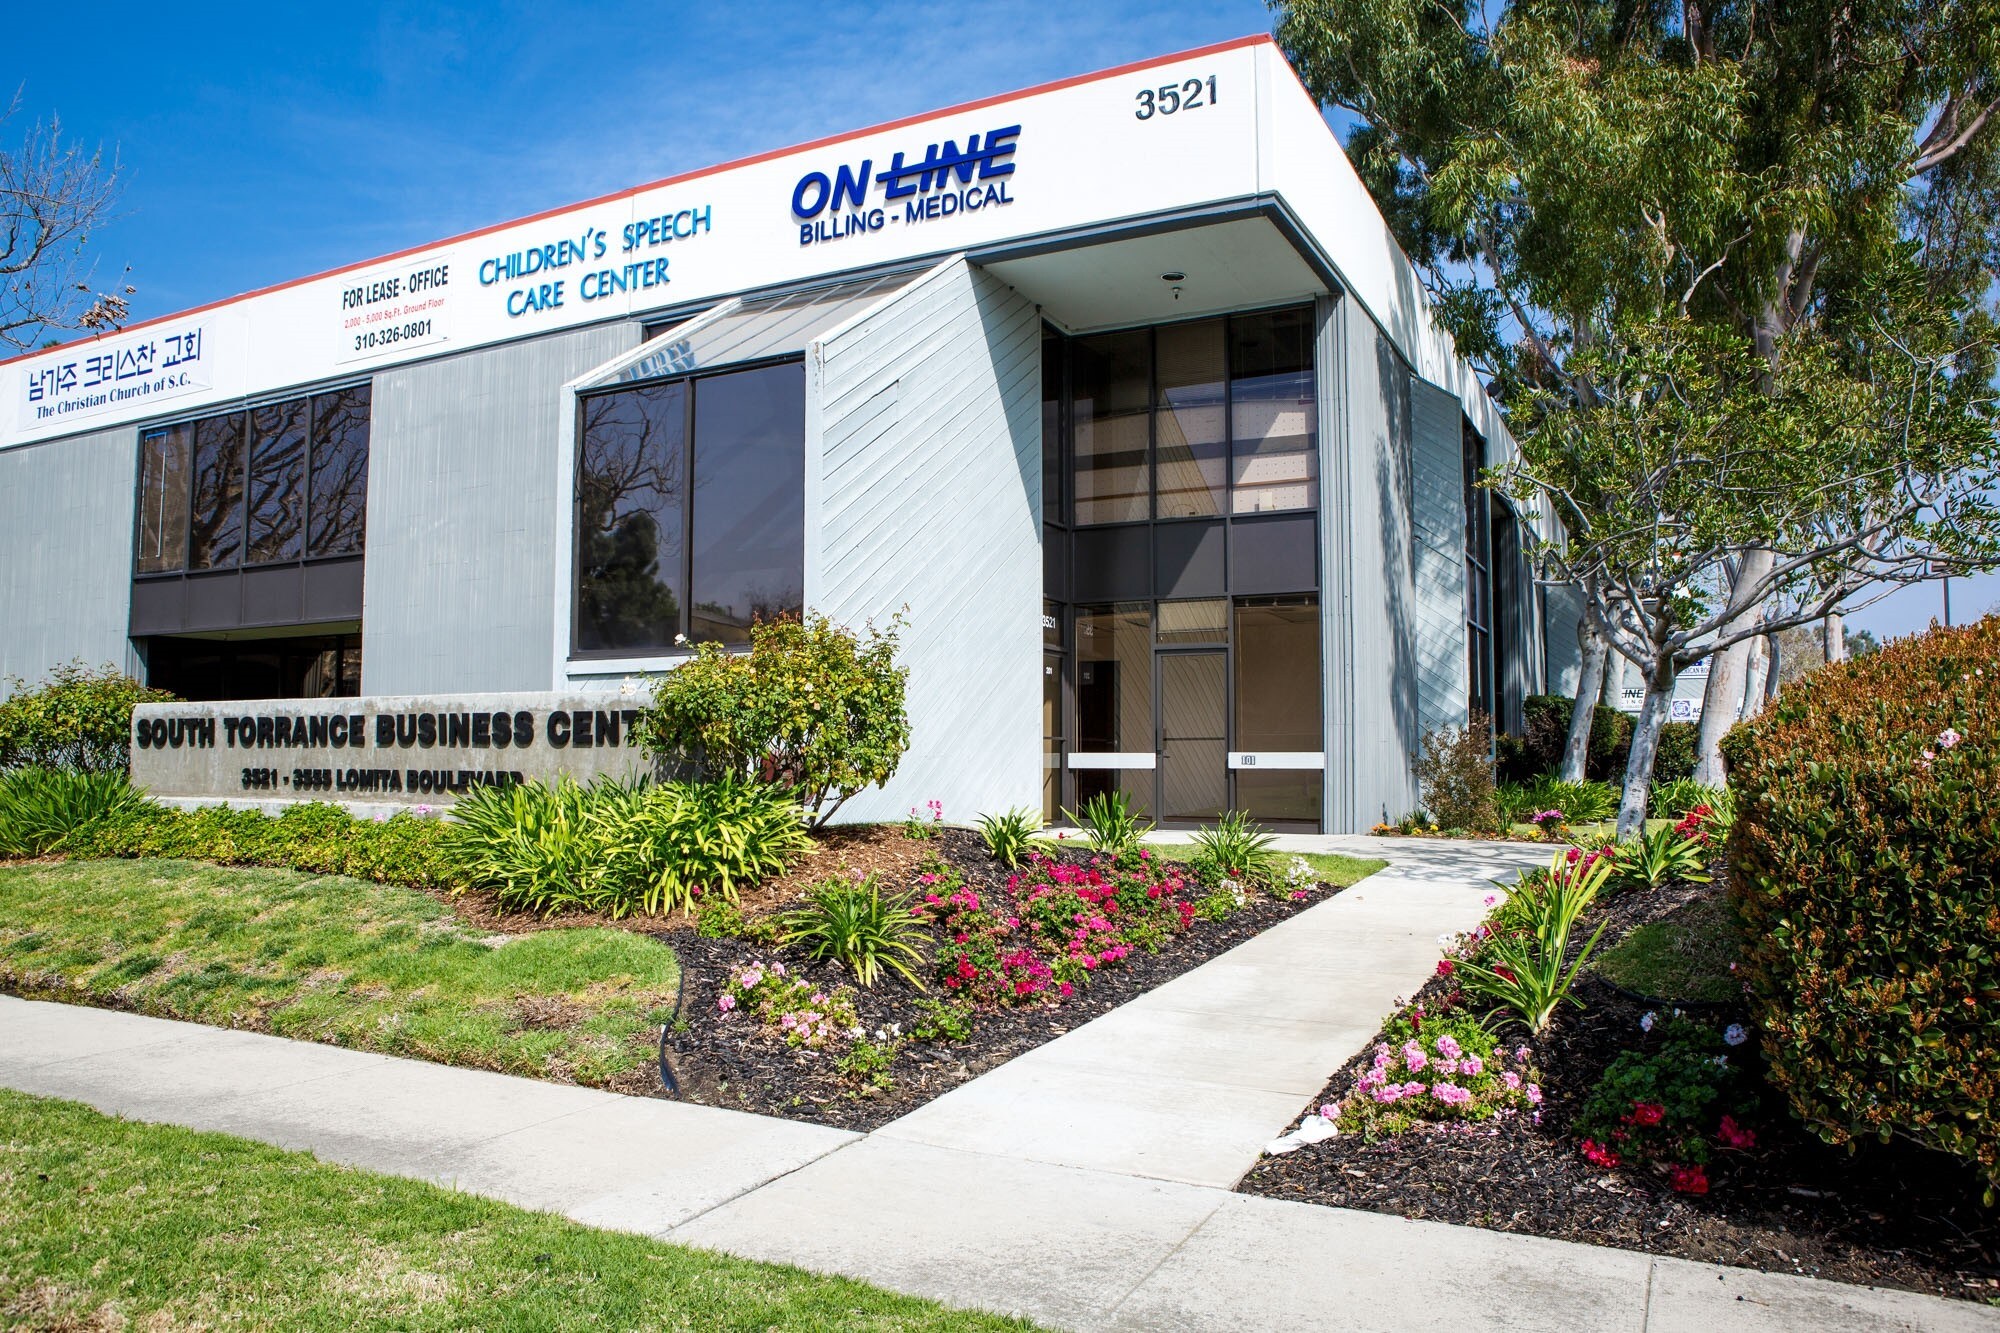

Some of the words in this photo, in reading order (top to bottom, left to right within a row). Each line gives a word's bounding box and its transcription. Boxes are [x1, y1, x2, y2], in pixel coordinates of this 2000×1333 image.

[1135, 74, 1217, 121] 3521
[799, 208, 885, 245] BILLING
[905, 181, 1014, 223] MEDICAL
[479, 226, 607, 285] CHILDREN'S
[622, 204, 711, 251] SPEECH
[342, 287, 363, 310] FOR
[366, 277, 400, 305] LEASE
[409, 265, 449, 293] OFFICE
[403, 301, 427, 314] Ground
[428, 298, 445, 308] Floor
[506, 280, 565, 316] CARE
[580, 257, 671, 301] CENTER
[355, 319, 431, 351] 310-326-0801
[29, 363, 77, 402] 남가주
[84, 341, 156, 387] 크리스찬
[162, 327, 202, 368] 교회
[36, 406, 55, 419] The
[57, 394, 107, 415] Christian
[109, 381, 151, 403] Church
[153, 377, 167, 392] of
[168, 372, 191, 389] S.C.
[1042, 614, 1056, 629] 3521
[1621, 689, 1644, 698] INE
[137, 718, 217, 749] SOUTH
[223, 715, 366, 749] TORRANCE
[376, 711, 535, 749] BUSINESS
[241, 768, 279, 790] 3521
[336, 769, 403, 793] LOMITA
[1241, 755, 1256, 765] 101
